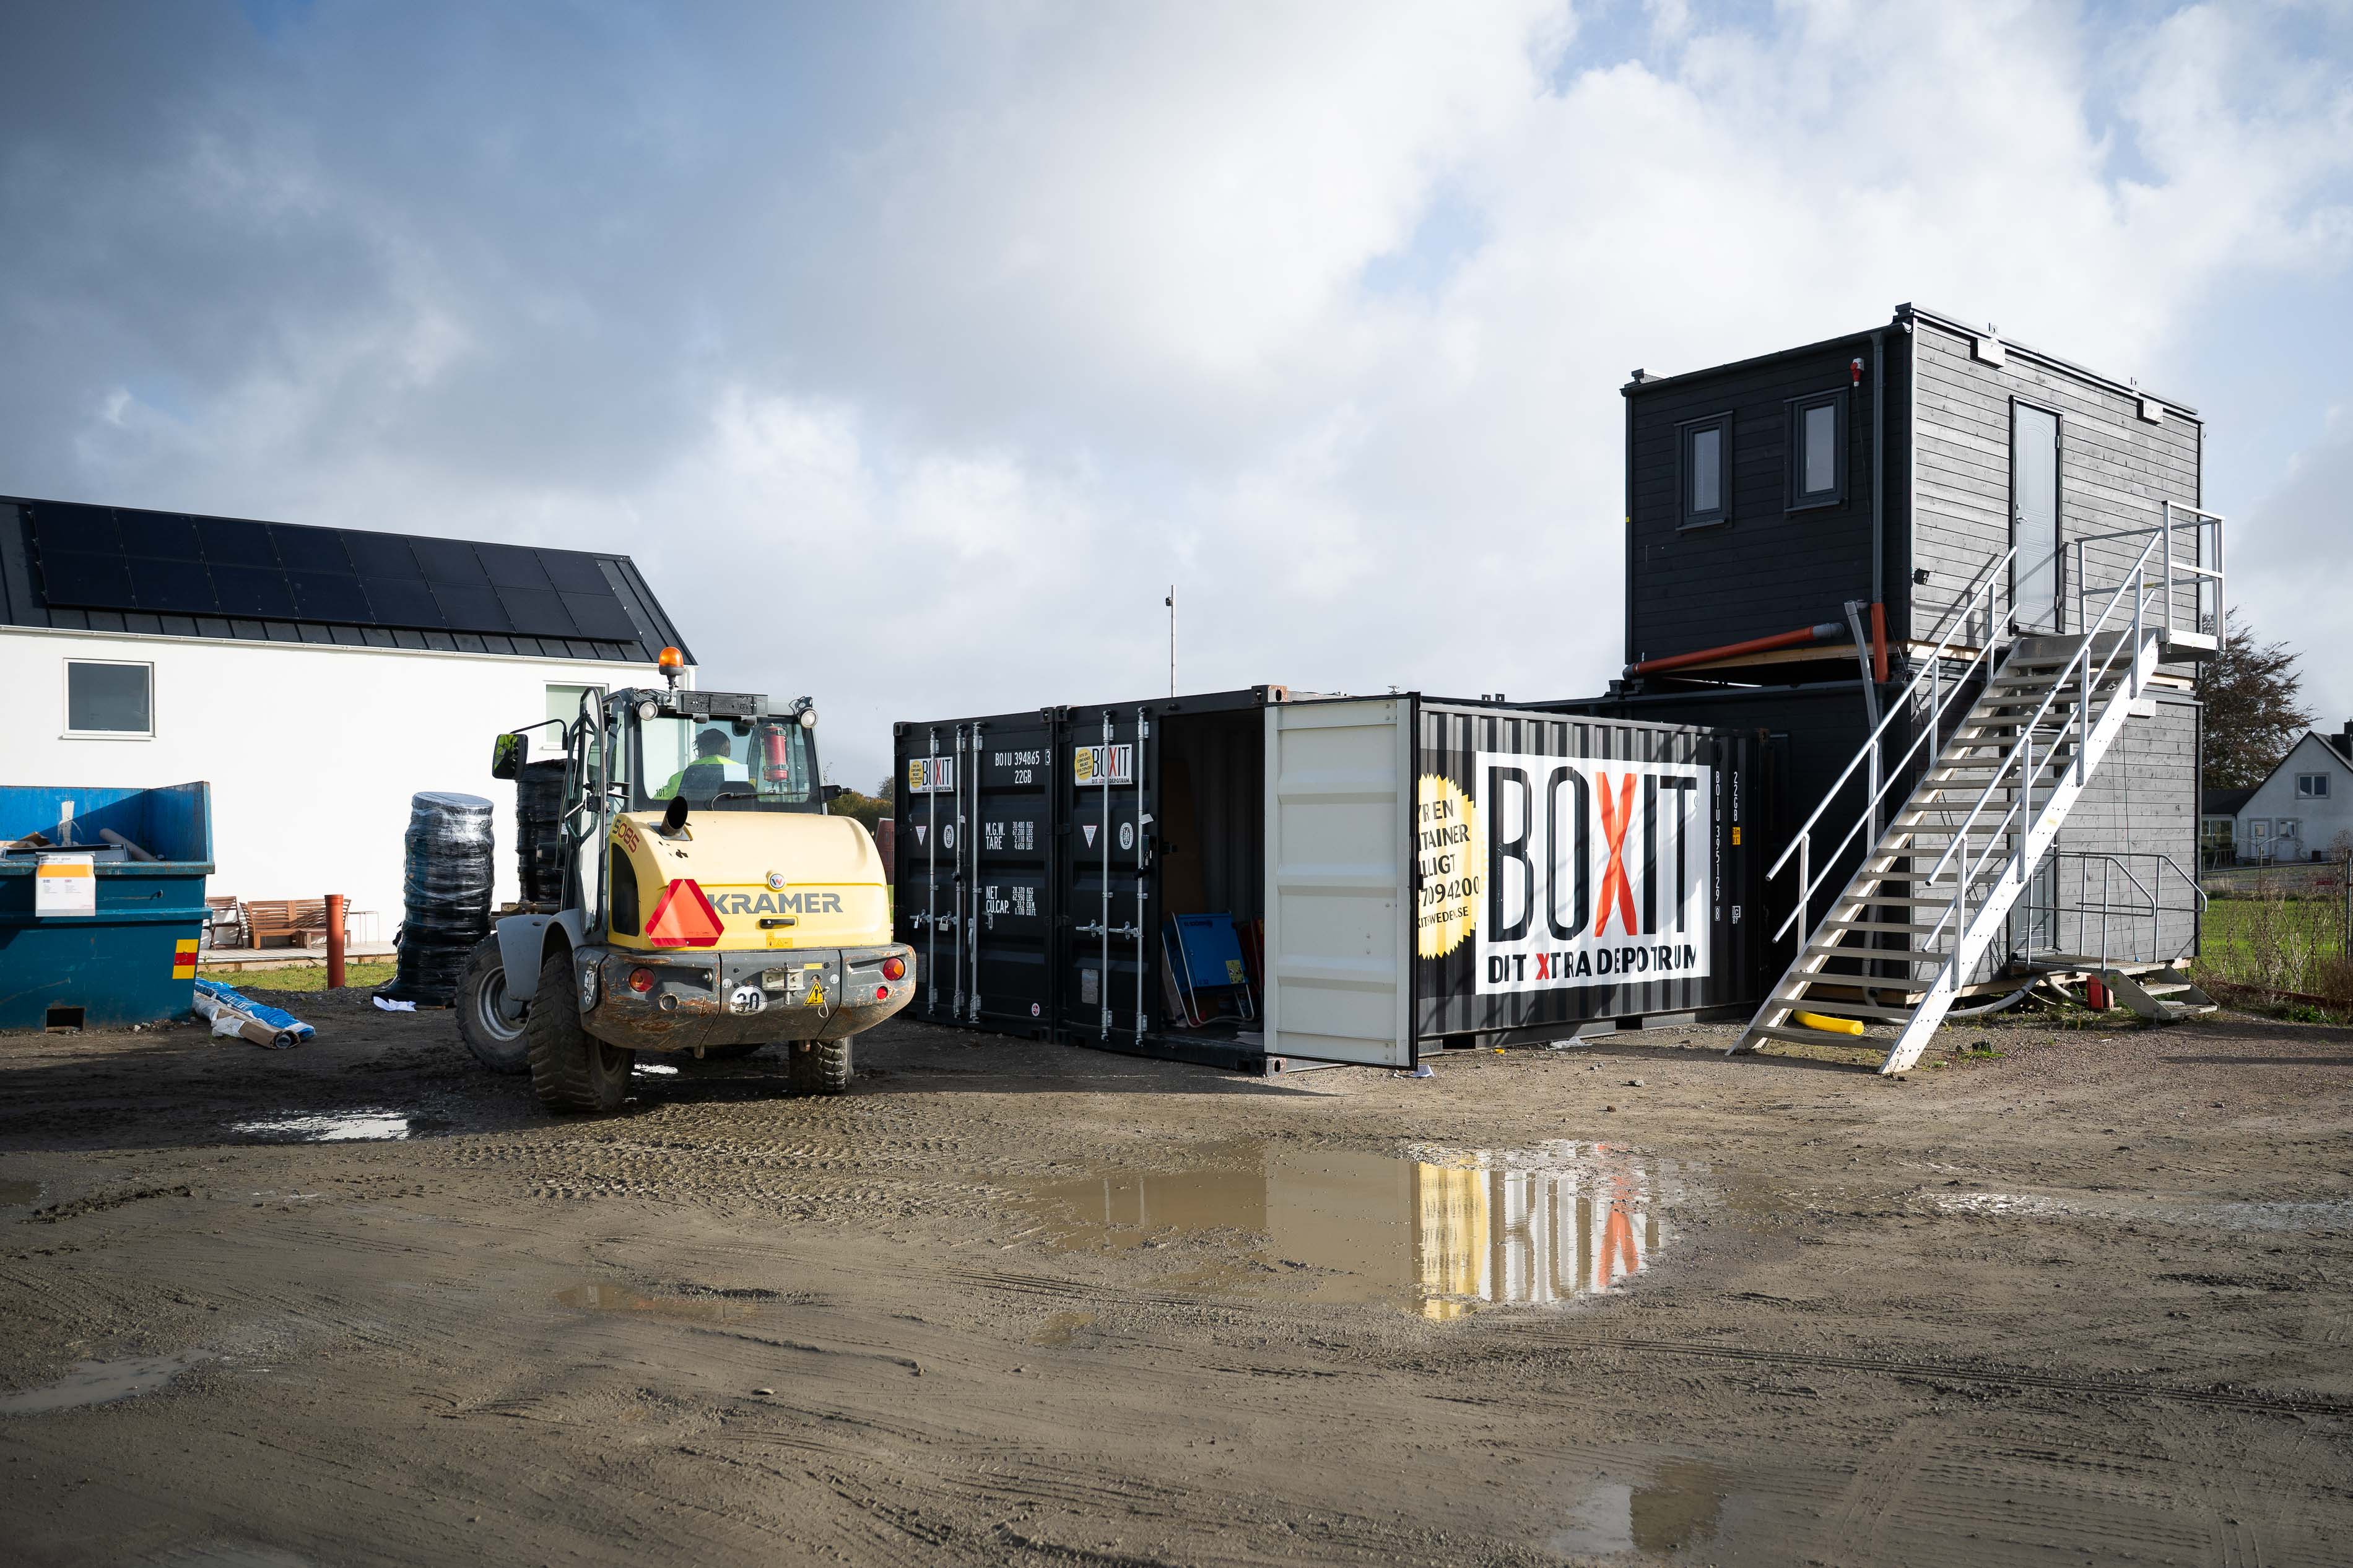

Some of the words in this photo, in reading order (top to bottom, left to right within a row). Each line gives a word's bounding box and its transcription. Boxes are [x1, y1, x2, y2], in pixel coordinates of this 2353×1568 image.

[995, 752, 1012, 766] BOIU
[1014, 751, 1040, 766] 394865
[1045, 750, 1051, 764] 3
[1015, 769, 1032, 784] 22GB
[656, 788, 665, 797] 101
[1433, 799, 1453, 820] EN
[612, 818, 640, 853] 5085
[986, 822, 1005, 836] M.G.W.
[986, 836, 1003, 850] TARE
[1419, 824, 1471, 851] TAINER
[1487, 766, 1697, 942] BOXIT
[986, 886, 998, 899] NET
[1419, 876, 1479, 907] 7094200
[707, 893, 843, 914] KRAMER
[986, 900, 1009, 914] CU.CAP.
[1716, 907, 1720, 920] 8
[1488, 954, 1527, 983] DIT
[1536, 950, 1592, 980] XTRA
[1597, 944, 1697, 975] DEPOTRUM
